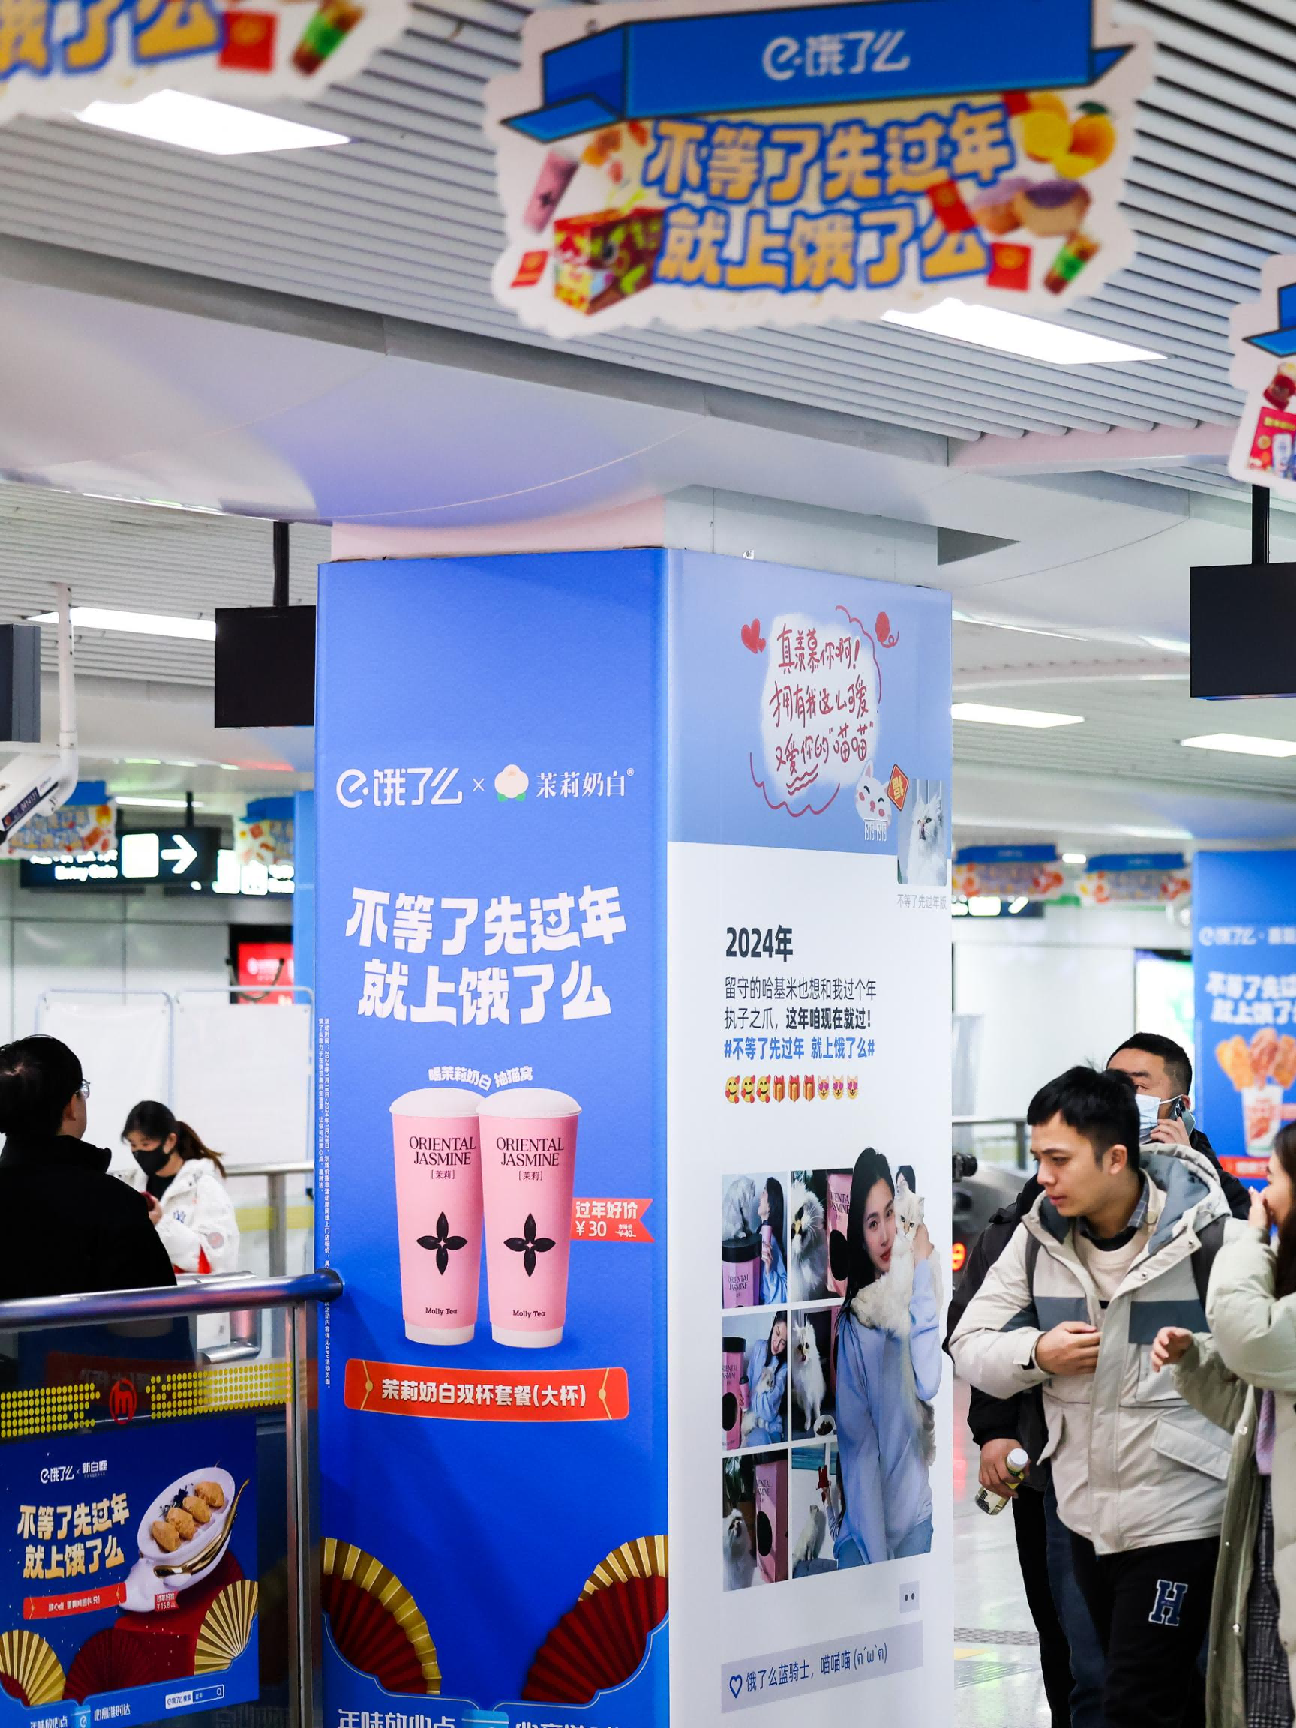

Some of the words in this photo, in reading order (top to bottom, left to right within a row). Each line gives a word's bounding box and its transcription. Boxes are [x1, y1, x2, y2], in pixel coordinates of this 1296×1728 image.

[646, 102, 1014, 199] 不等了先过年
[657, 205, 995, 291] 就上饿了么
[345, 885, 627, 956] 不等了先过年
[725, 924, 794, 962] 2024年
[357, 958, 611, 1026] 就上饿了么
[724, 976, 877, 1001] 留守的哈基米也想和我过个年
[409, 1136, 476, 1152] ORIENTAL
[413, 1152, 472, 1166] JASMINE
[496, 1136, 564, 1152] ORIENTAL
[500, 1152, 560, 1167] JASMINE
[575, 1201, 638, 1219] 过年好价
[425, 1306, 444, 1317] Molly
[512, 1309, 531, 1319] Molly
[17, 1492, 130, 1541] 不等了先过年
[23, 1534, 125, 1580] 就上饿了么
[1148, 1579, 1188, 1627] H
